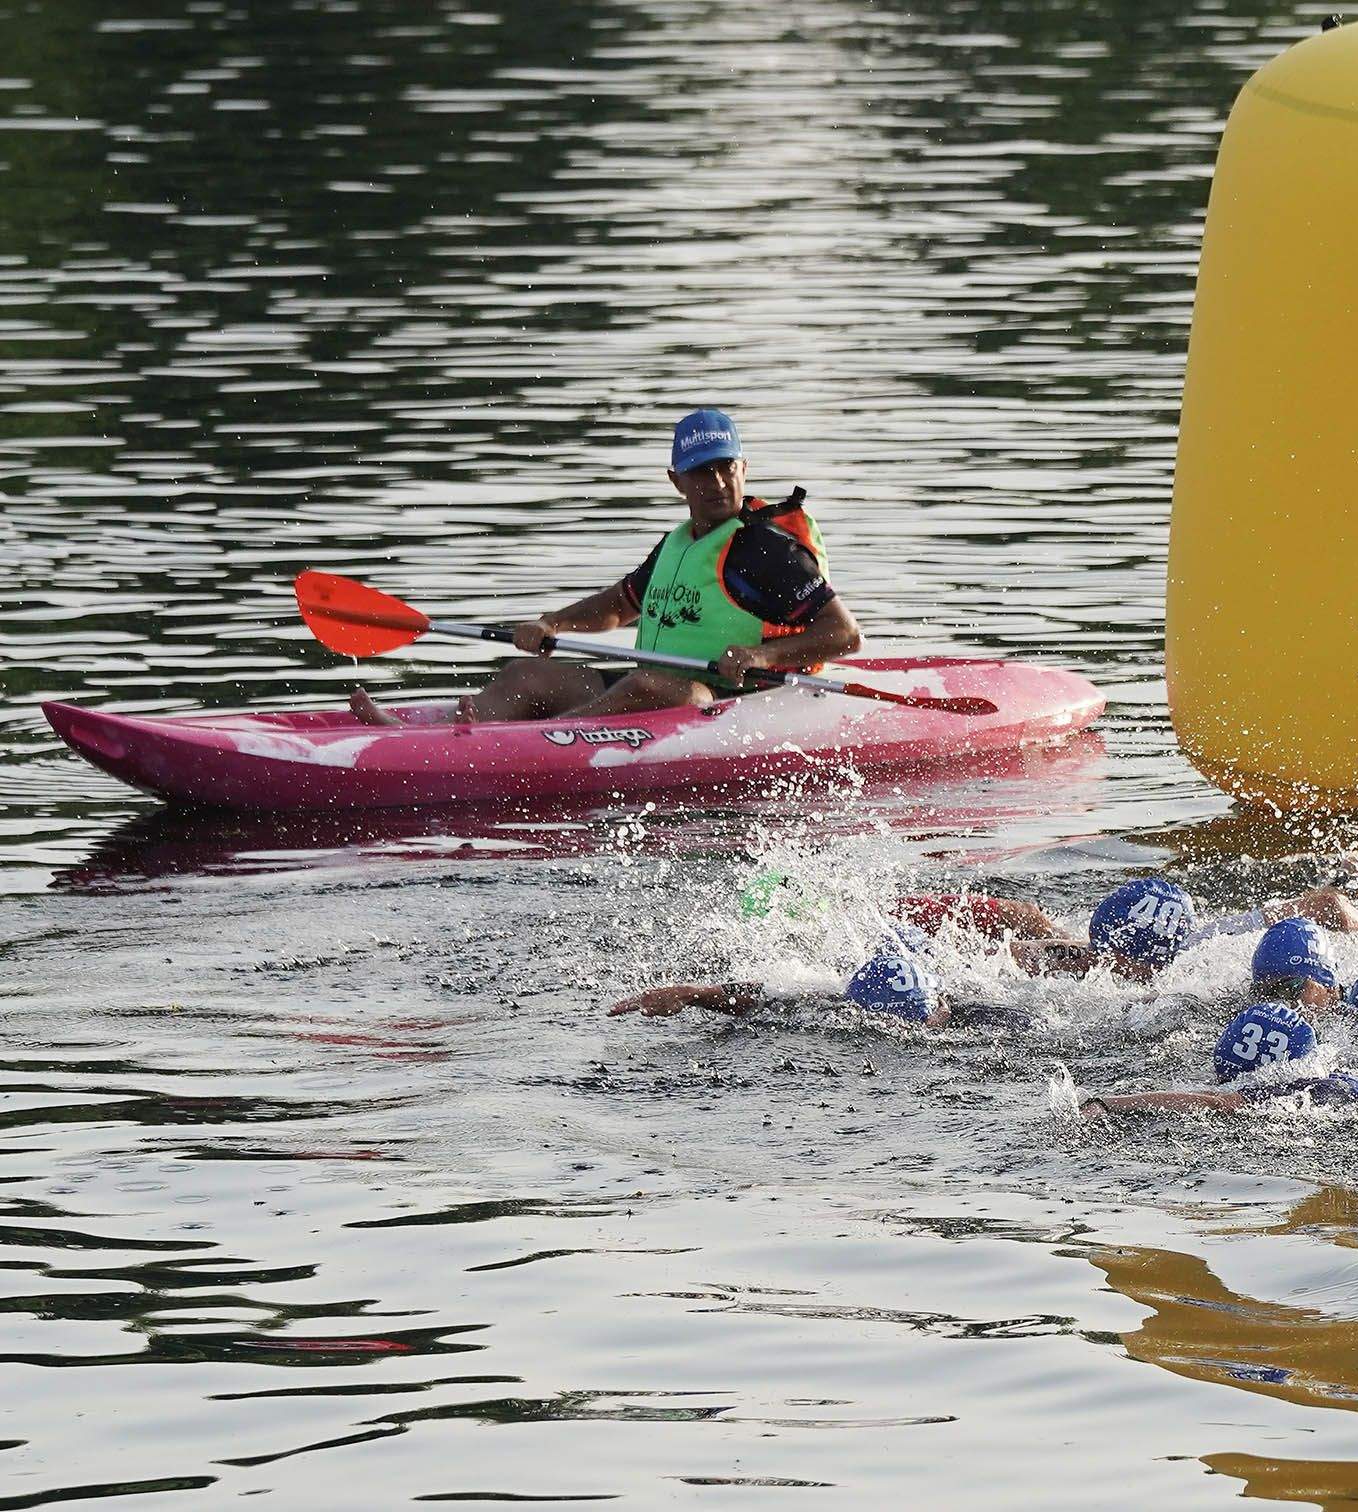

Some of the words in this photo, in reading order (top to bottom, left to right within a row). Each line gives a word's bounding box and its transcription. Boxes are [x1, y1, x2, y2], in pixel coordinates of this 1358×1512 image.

[681, 430, 732, 450] Multisport
[1127, 894, 1184, 938] 40
[1232, 1022, 1288, 1064] 33
